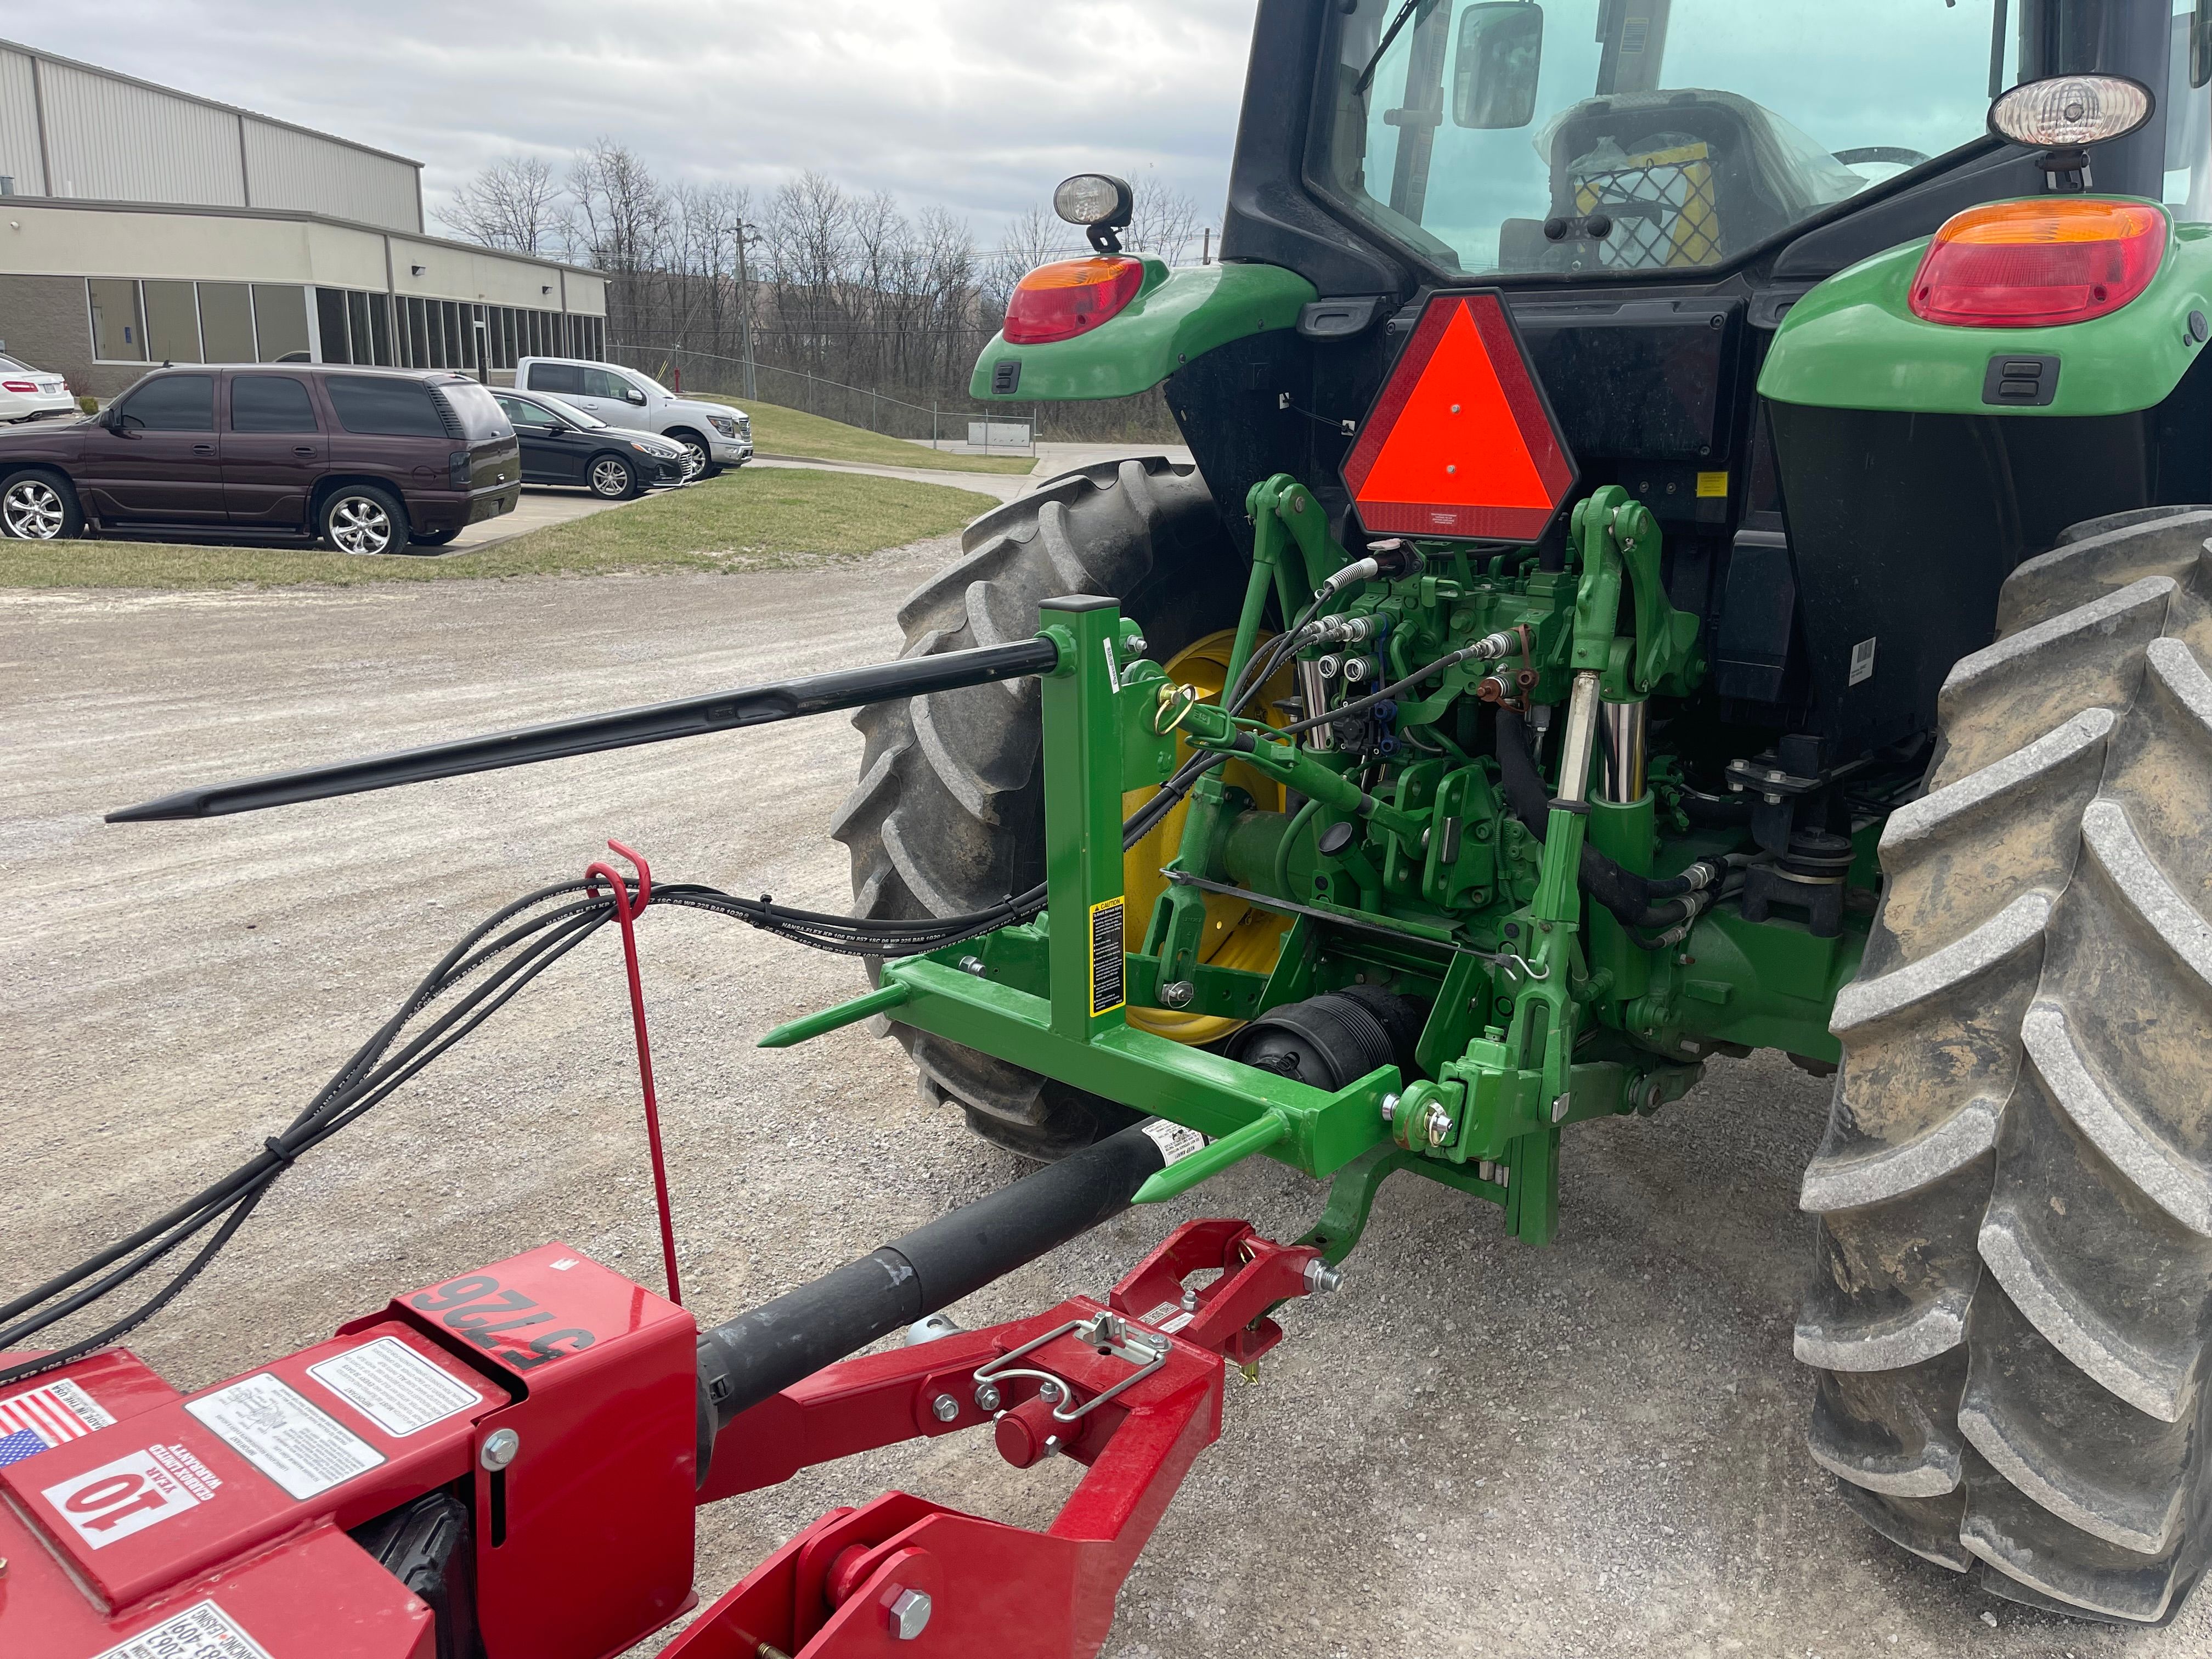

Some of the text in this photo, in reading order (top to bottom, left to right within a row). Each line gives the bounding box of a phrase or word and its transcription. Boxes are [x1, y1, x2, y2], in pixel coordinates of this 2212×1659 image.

[543, 893, 554, 901] EN
[1101, 898, 1120, 909] CAUTION
[710, 905, 726, 913] BAR
[545, 905, 597, 927] HANSA-FLEX
[775, 929, 785, 938] EN
[781, 922, 823, 935] HANSA-FLEX
[1186, 1146, 1195, 1154] KEEP
[411, 1276, 595, 1370] 5726
[340, 1363, 357, 1374] DAYS
[357, 1375, 376, 1387] EVERY
[394, 1373, 408, 1381] ALL
[50, 1385, 68, 1398] USA
[342, 1386, 375, 1408] IMPORTANT
[62, 1395, 81, 1408] THE
[378, 1400, 396, 1411] MUST
[74, 1407, 89, 1415] IN
[228, 1435, 258, 1457] IMPORTANT
[149, 1443, 216, 1501] GEARBOX LIMITED
[167, 1443, 224, 1491] WARRANTY
[145, 1466, 178, 1494] YEAR
[64, 1472, 169, 1532] 10
[191, 1609, 228, 1639] LEASING
